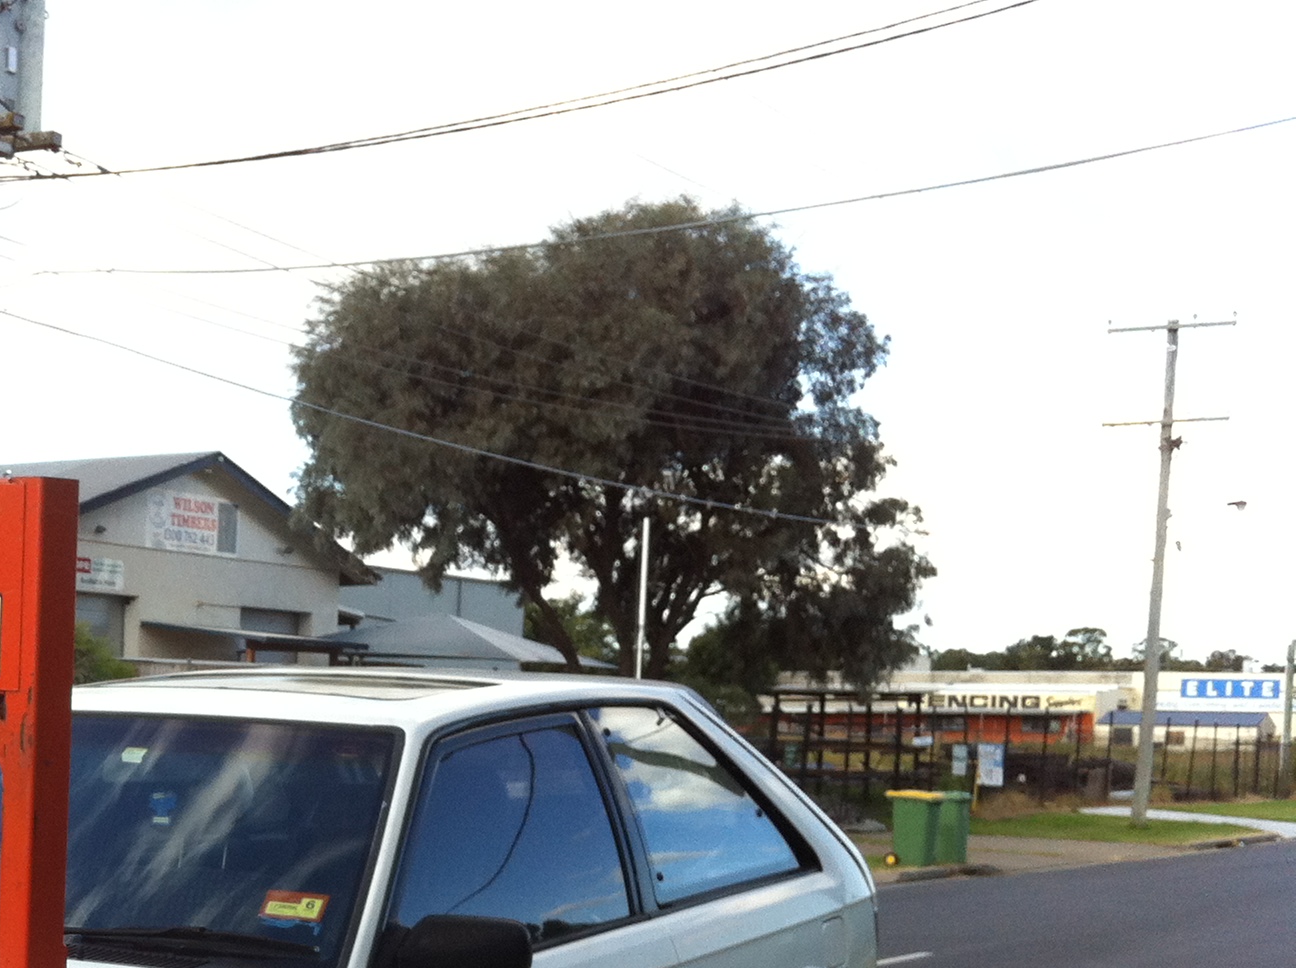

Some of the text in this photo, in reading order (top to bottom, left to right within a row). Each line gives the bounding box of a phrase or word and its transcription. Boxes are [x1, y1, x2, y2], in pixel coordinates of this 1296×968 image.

[173, 496, 215, 515] WILSON
[1186, 680, 1274, 698] ELITE
[306, 900, 315, 910] 6
